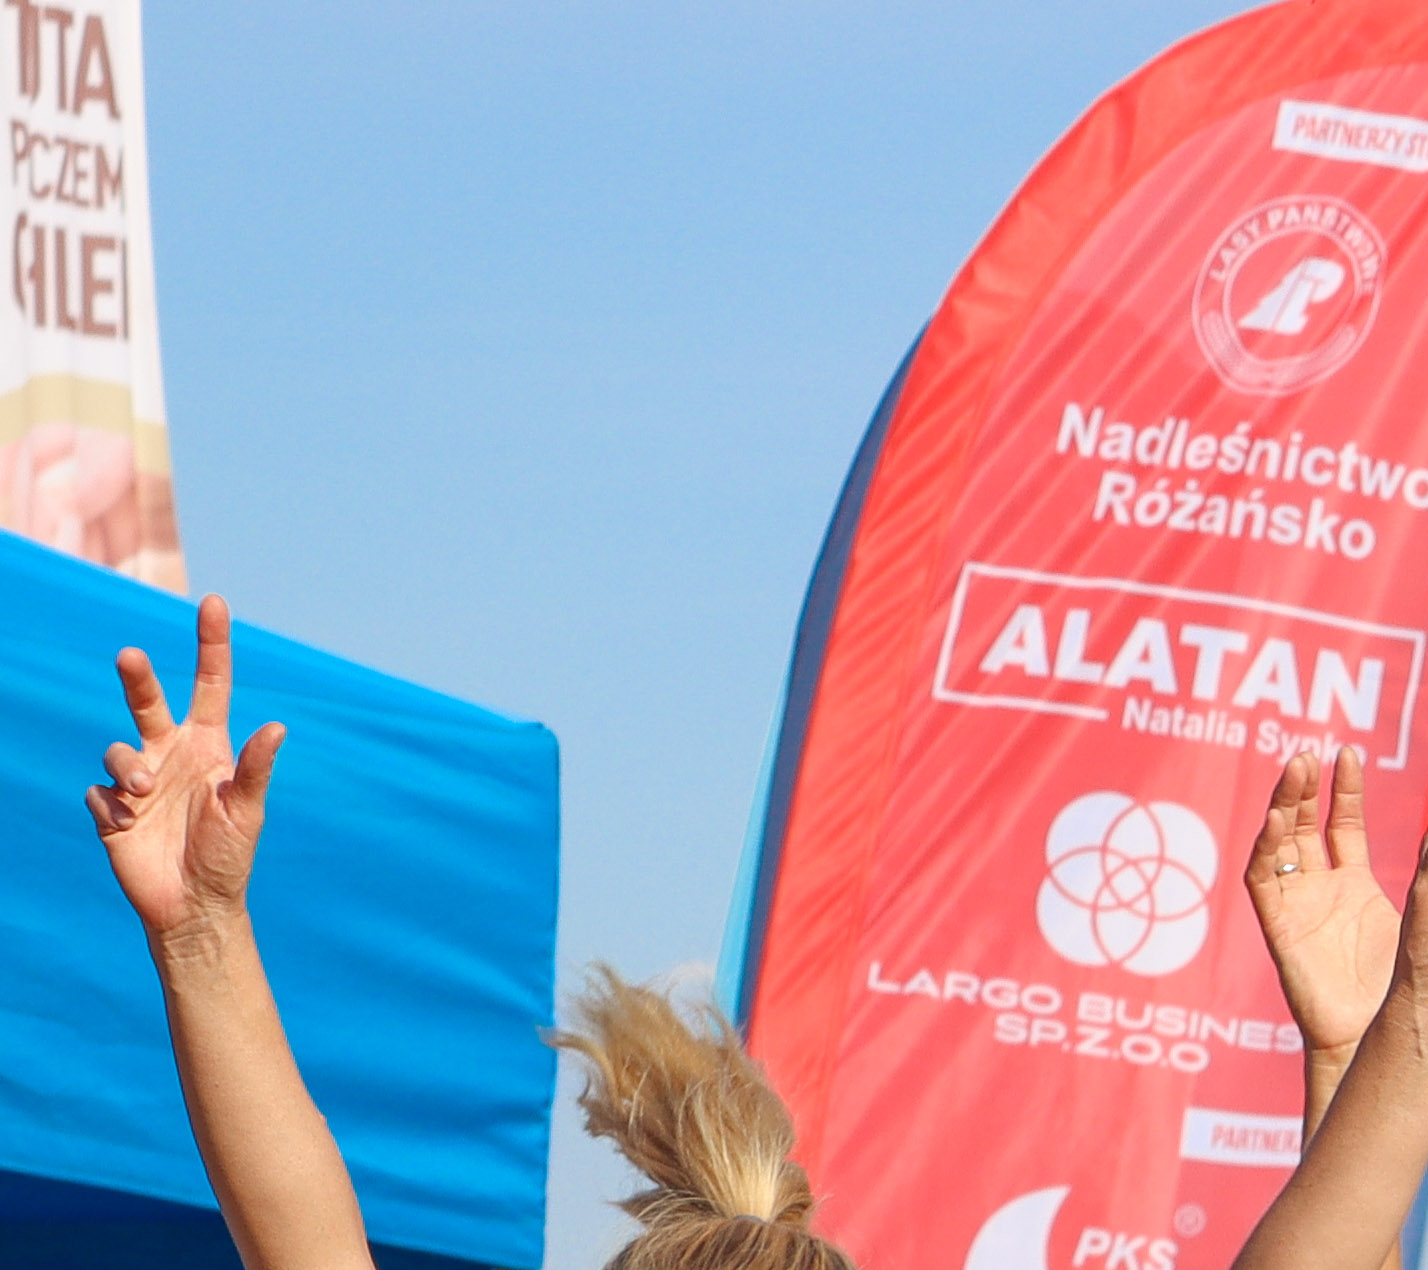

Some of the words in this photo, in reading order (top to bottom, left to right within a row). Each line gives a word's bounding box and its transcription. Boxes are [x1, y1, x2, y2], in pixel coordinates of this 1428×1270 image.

[1291, 113, 1408, 155] PARTNERZY
[1209, 219, 1261, 282] LASY
[1093, 470, 1378, 560] Różańsko
[979, 604, 1386, 731] ALATAN
[1121, 696, 1247, 749] Natalia
[867, 961, 1064, 1016] LARGO
